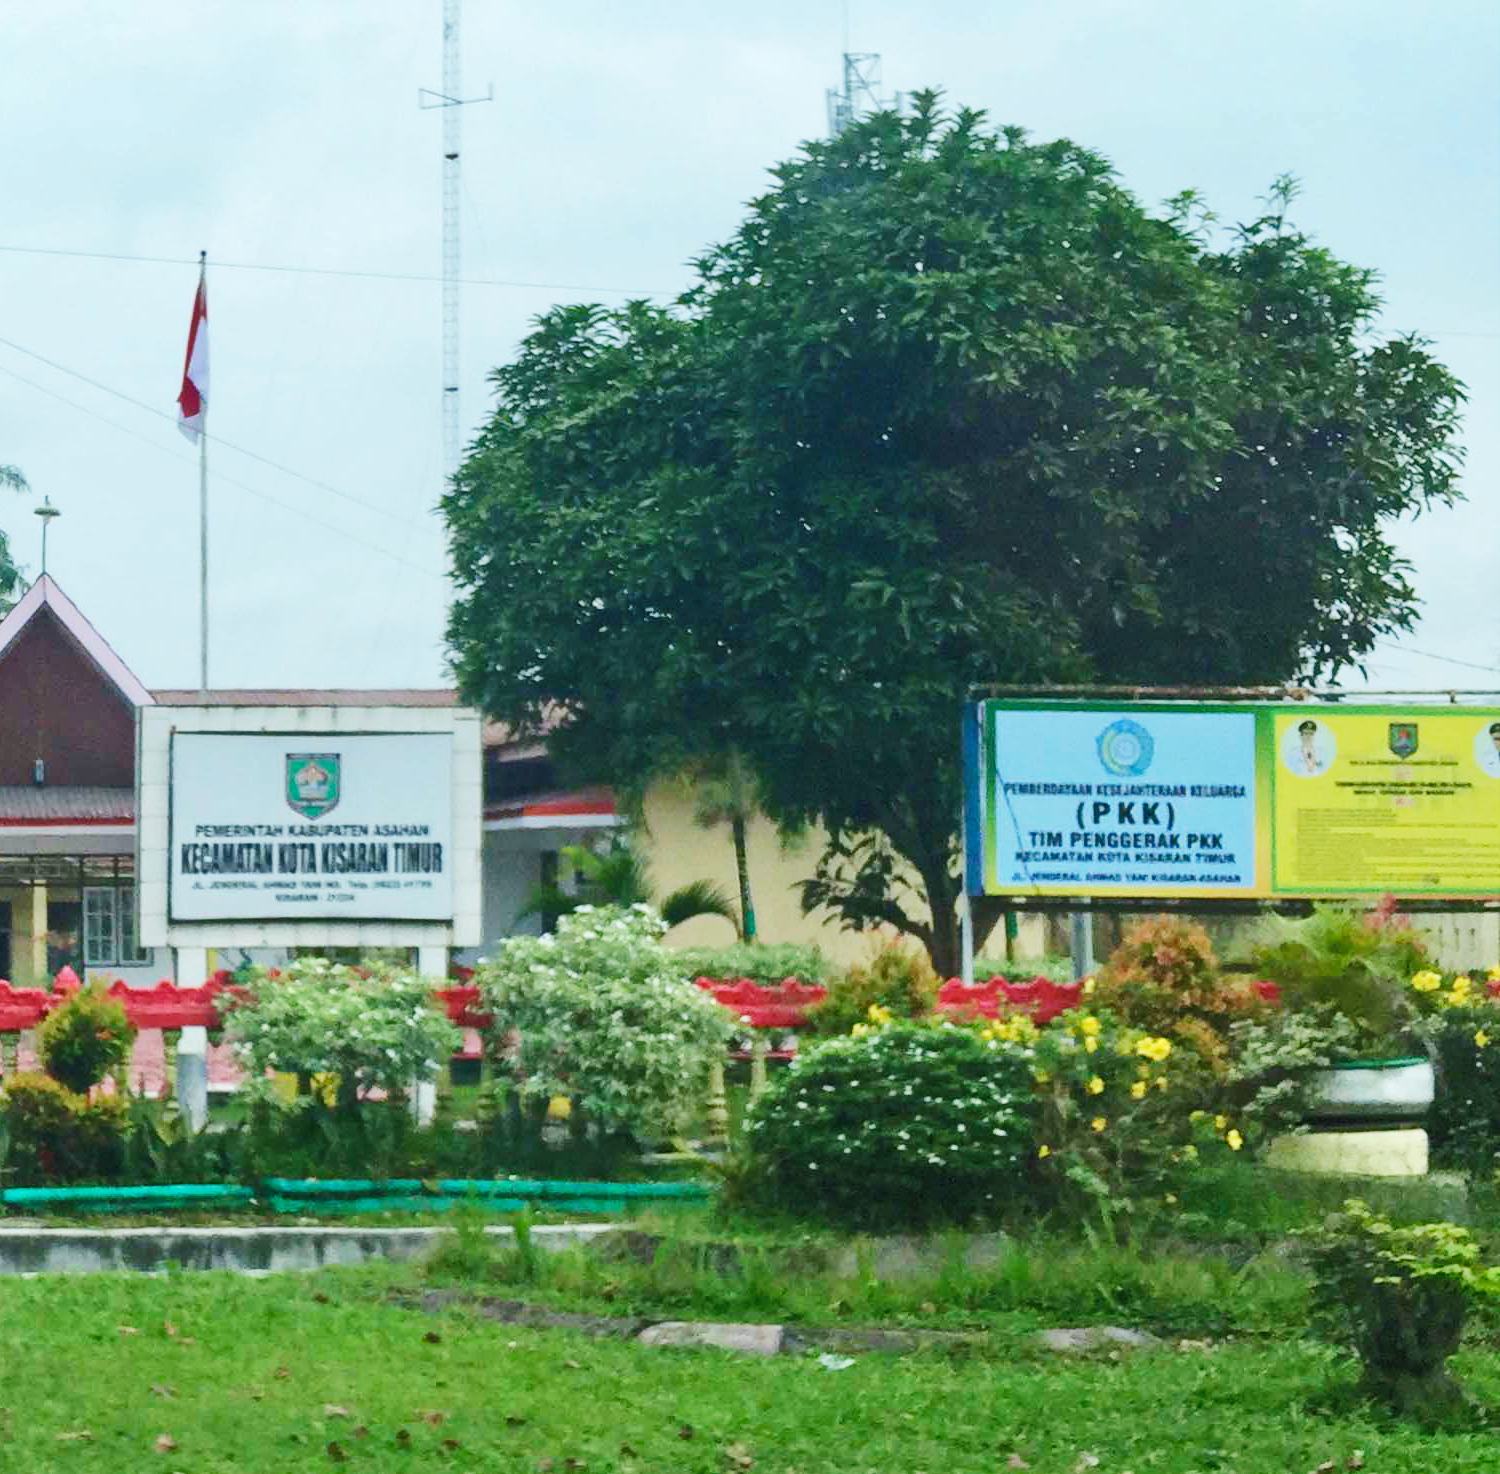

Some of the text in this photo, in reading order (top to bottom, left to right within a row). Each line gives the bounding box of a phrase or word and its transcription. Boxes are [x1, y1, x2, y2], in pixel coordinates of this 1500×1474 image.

[1003, 782, 1093, 796] PEMBERDAYAAN
[1190, 784, 1246, 798] KELUARGA
[195, 824, 430, 838] PEMERINTAH KABUPATEN ASAHAN
[1029, 831, 1223, 849] TIM PENGGERAK PKK
[181, 842, 443, 875] KECAMATAN KOTA KISARAN TIMUR
[1015, 852, 1236, 864] KECAMATAN KOTA KISARAN TIMUR
